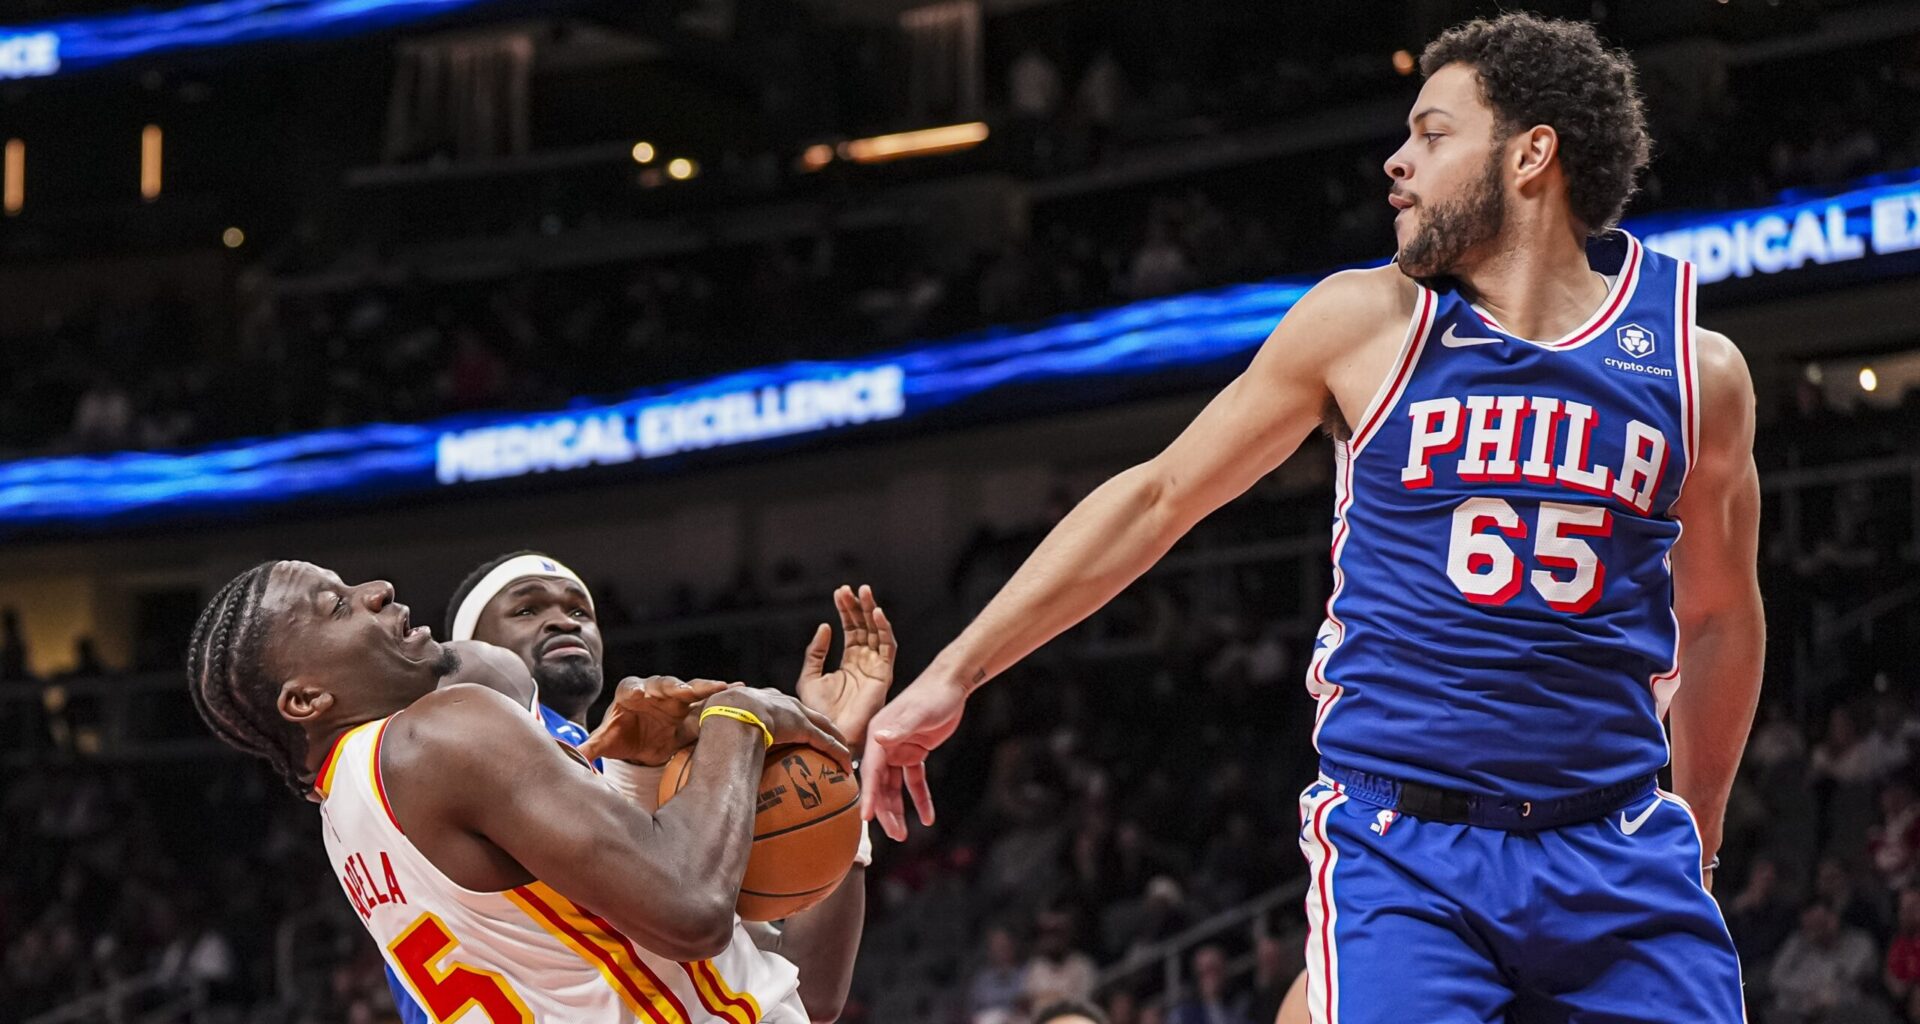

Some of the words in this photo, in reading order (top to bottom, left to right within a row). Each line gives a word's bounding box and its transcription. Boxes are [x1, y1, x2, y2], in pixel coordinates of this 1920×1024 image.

[436, 412, 637, 484] MEDICAL
[637, 364, 904, 459] EXCELLENCE
[1604, 357, 1672, 377] crypto.com
[1401, 396, 1670, 516] PHILA
[1446, 497, 1614, 613] 65
